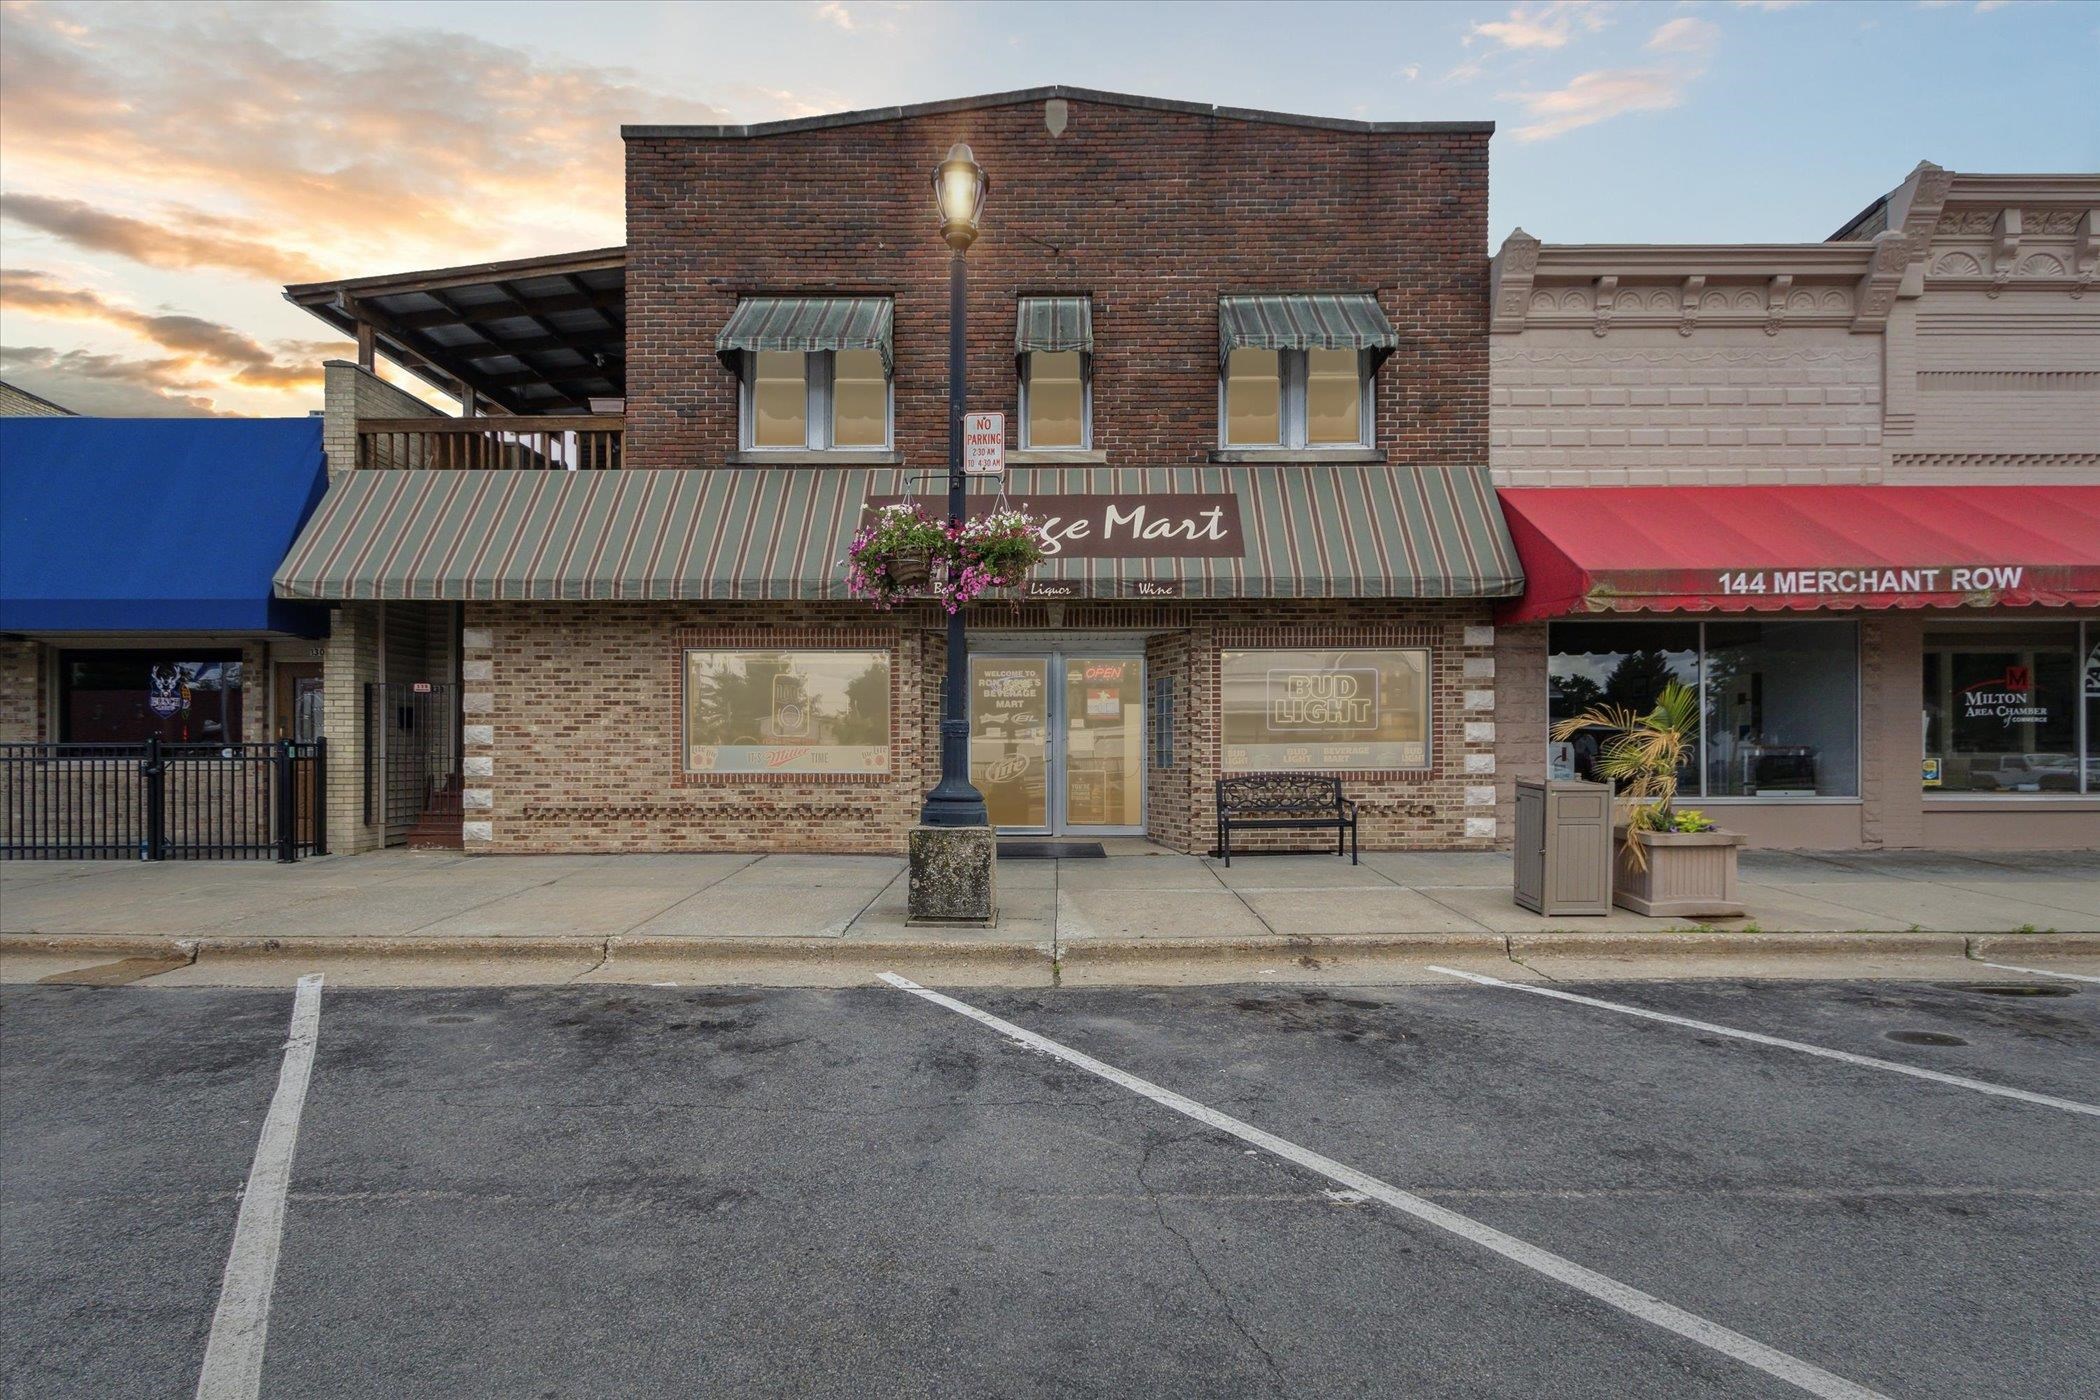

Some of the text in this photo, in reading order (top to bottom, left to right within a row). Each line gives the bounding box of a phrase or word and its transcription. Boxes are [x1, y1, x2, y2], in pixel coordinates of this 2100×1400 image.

[976, 419, 991, 430] NO
[967, 433, 1001, 445] PARKING
[968, 459, 975, 467] TO
[1104, 504, 1228, 541] Mart
[1719, 566, 2023, 594] 144 MERCHANT ROW
[1030, 582, 1072, 597] Liquor
[1138, 582, 1173, 595] Wine
[984, 670, 1024, 678] WELCOME
[1086, 667, 1122, 678] OPEN
[1288, 675, 1358, 699] BUD
[983, 689, 1037, 698] BEVERAGE
[1965, 691, 2027, 706] MILTON
[996, 700, 1024, 708] MART
[1275, 699, 1372, 724] LIGHT
[1965, 705, 2047, 717] AREA CHAMBER
[2003, 715, 2012, 728] of
[1227, 749, 1246, 757] BUD
[1286, 748, 1308, 756] BUD
[1323, 747, 1370, 755] BEVERAGE
[1403, 747, 1424, 755] BUD
[811, 751, 829, 764] TIME
[1225, 757, 1249, 765] LIGHT
[1283, 755, 1311, 763] LIGHT
